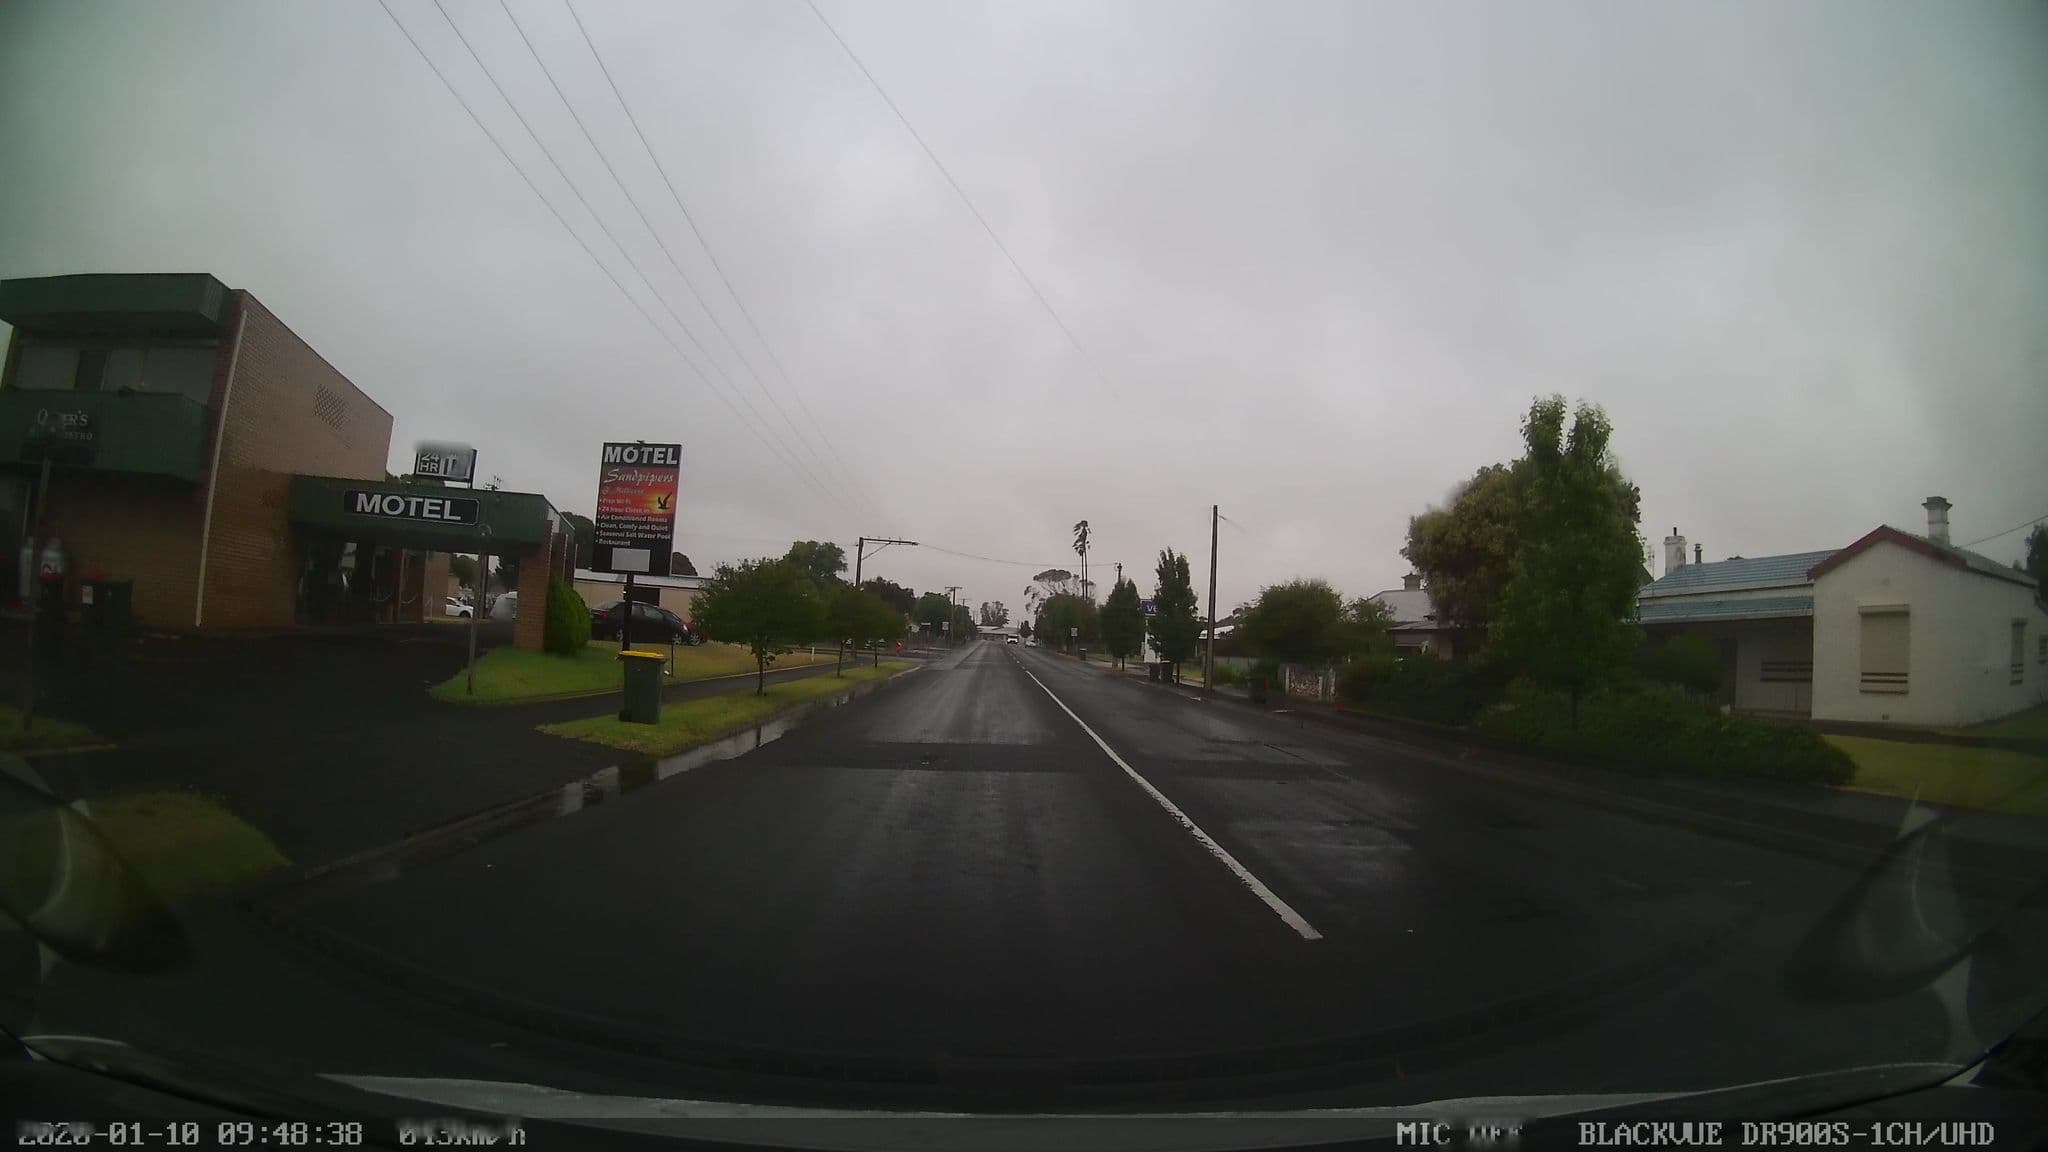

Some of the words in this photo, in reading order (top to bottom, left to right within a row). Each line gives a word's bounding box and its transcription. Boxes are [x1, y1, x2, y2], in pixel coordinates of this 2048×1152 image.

[421, 450, 440, 462] 24
[604, 446, 678, 465] MOTEL
[420, 462, 439, 473] HR
[603, 468, 674, 486] Sandpipers
[356, 493, 462, 521] MOTEL
[619, 523, 637, 531] Comfy
[599, 530, 625, 538] Seasonal
[638, 532, 656, 540] Water
[598, 539, 631, 547] Restaurant
